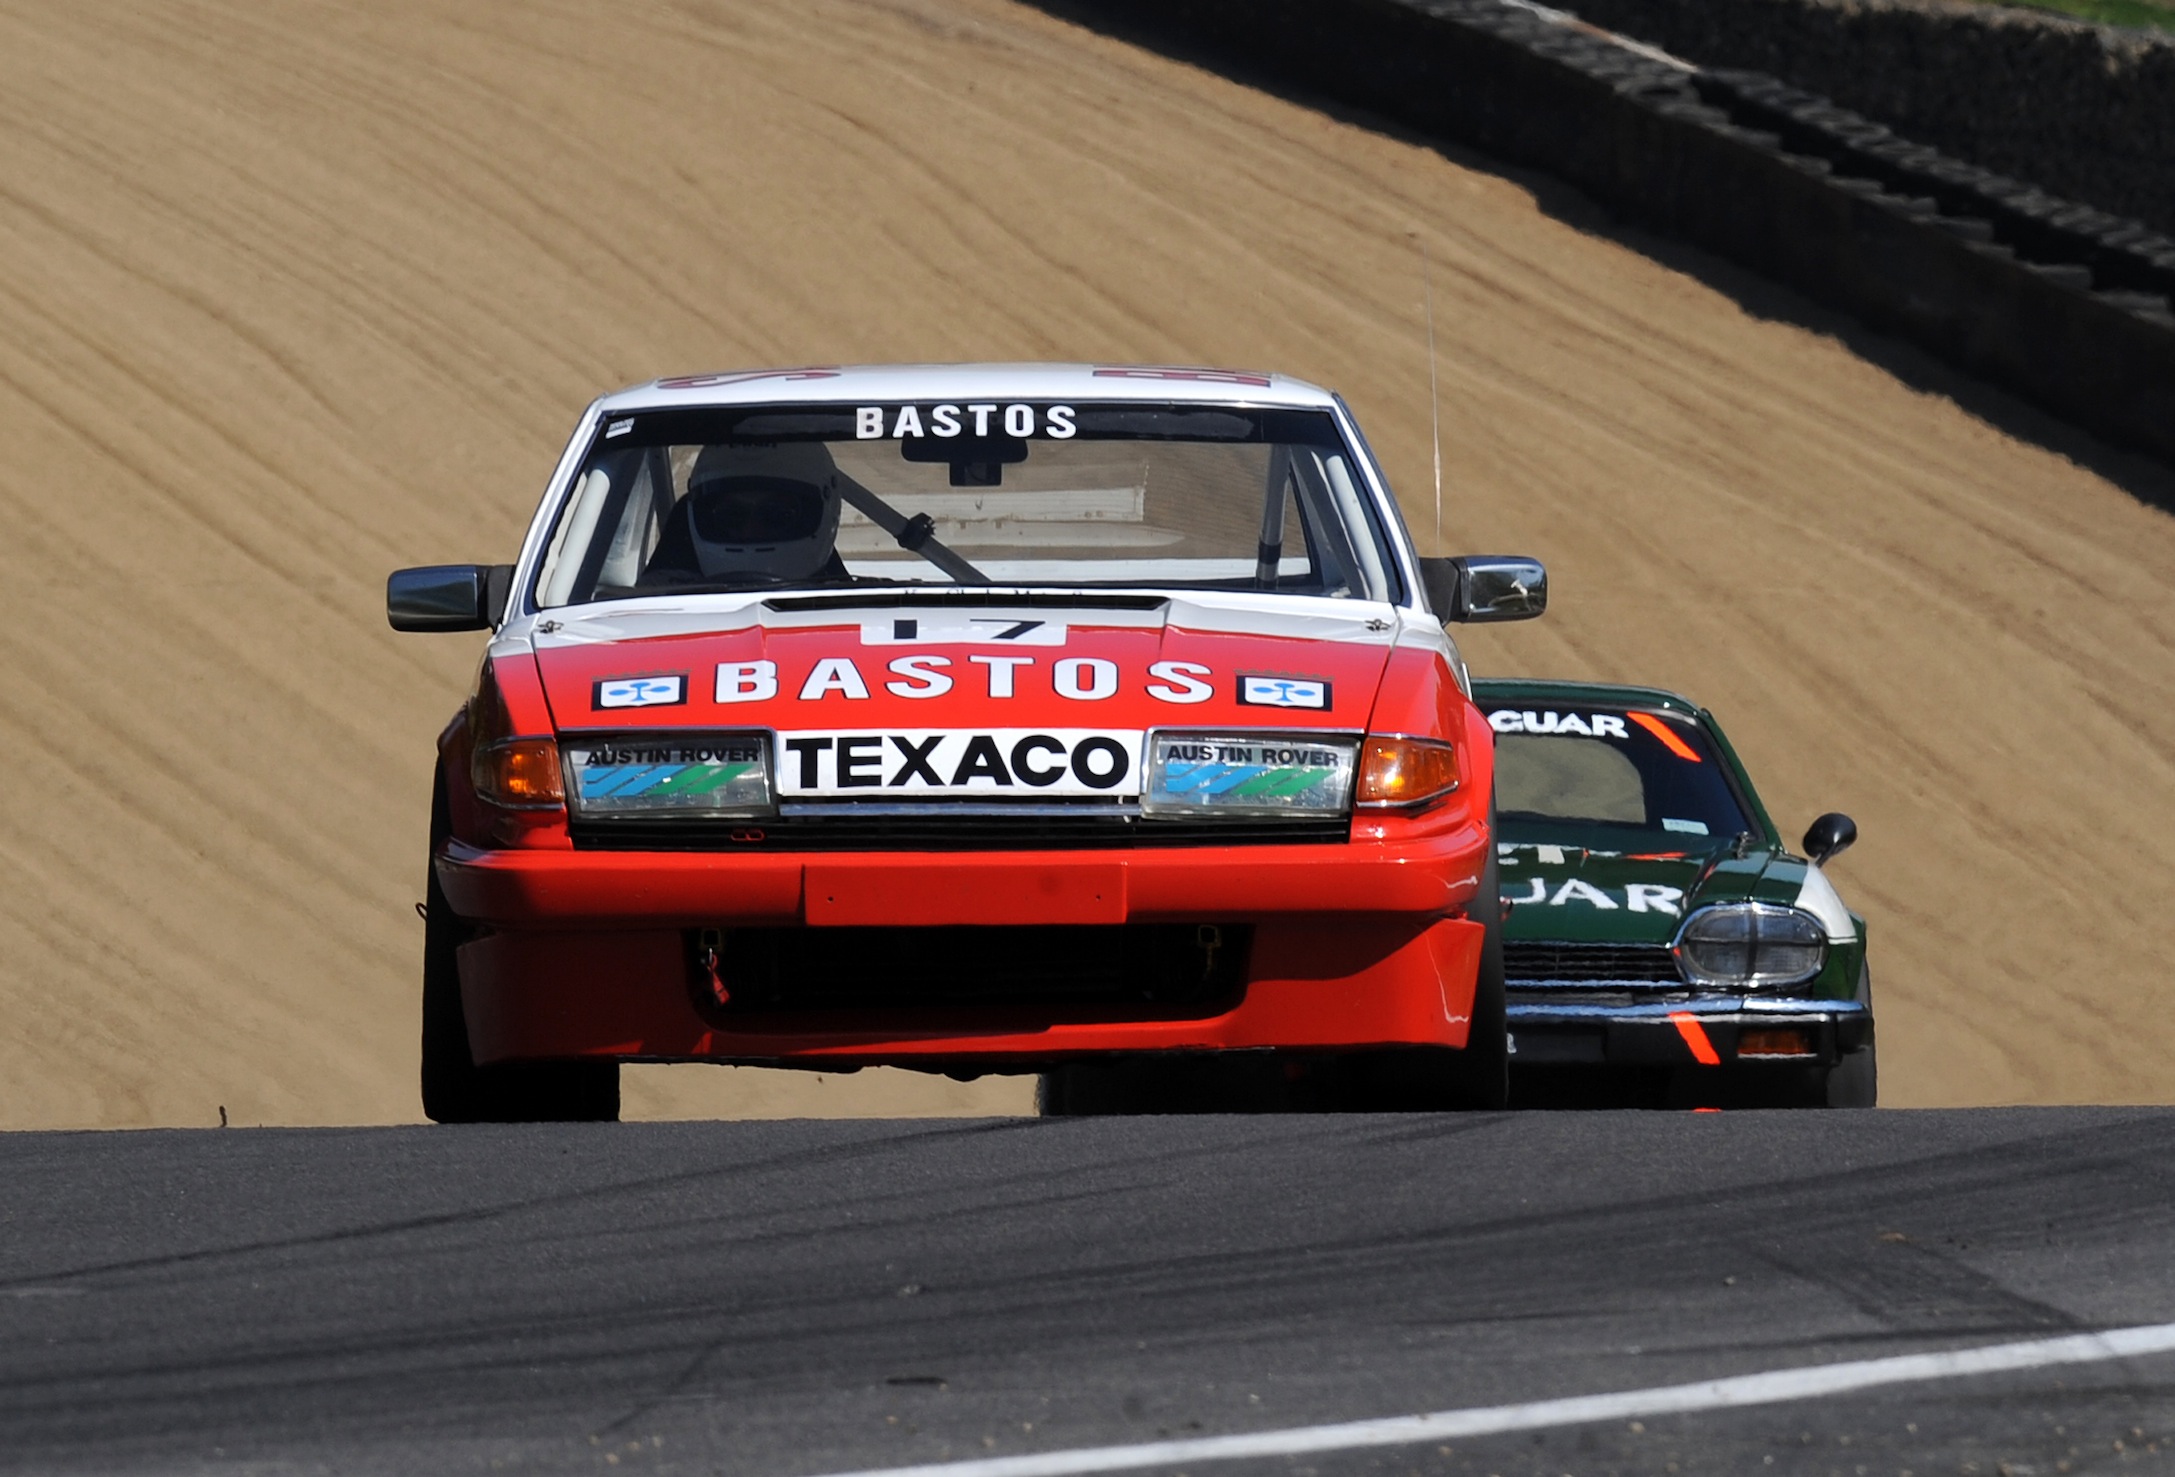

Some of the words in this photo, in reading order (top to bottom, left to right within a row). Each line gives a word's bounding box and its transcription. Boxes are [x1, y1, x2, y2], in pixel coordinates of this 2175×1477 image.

[855, 403, 1077, 439] BASTOS
[893, 618, 1046, 640] 17
[715, 655, 1214, 703] BASTOS
[585, 748, 672, 766] AUSTIN
[680, 747, 760, 763] ROVER
[785, 734, 1130, 789] TEXACO
[1166, 745, 1253, 763] AUSTIN
[1262, 748, 1339, 766] ROVER
